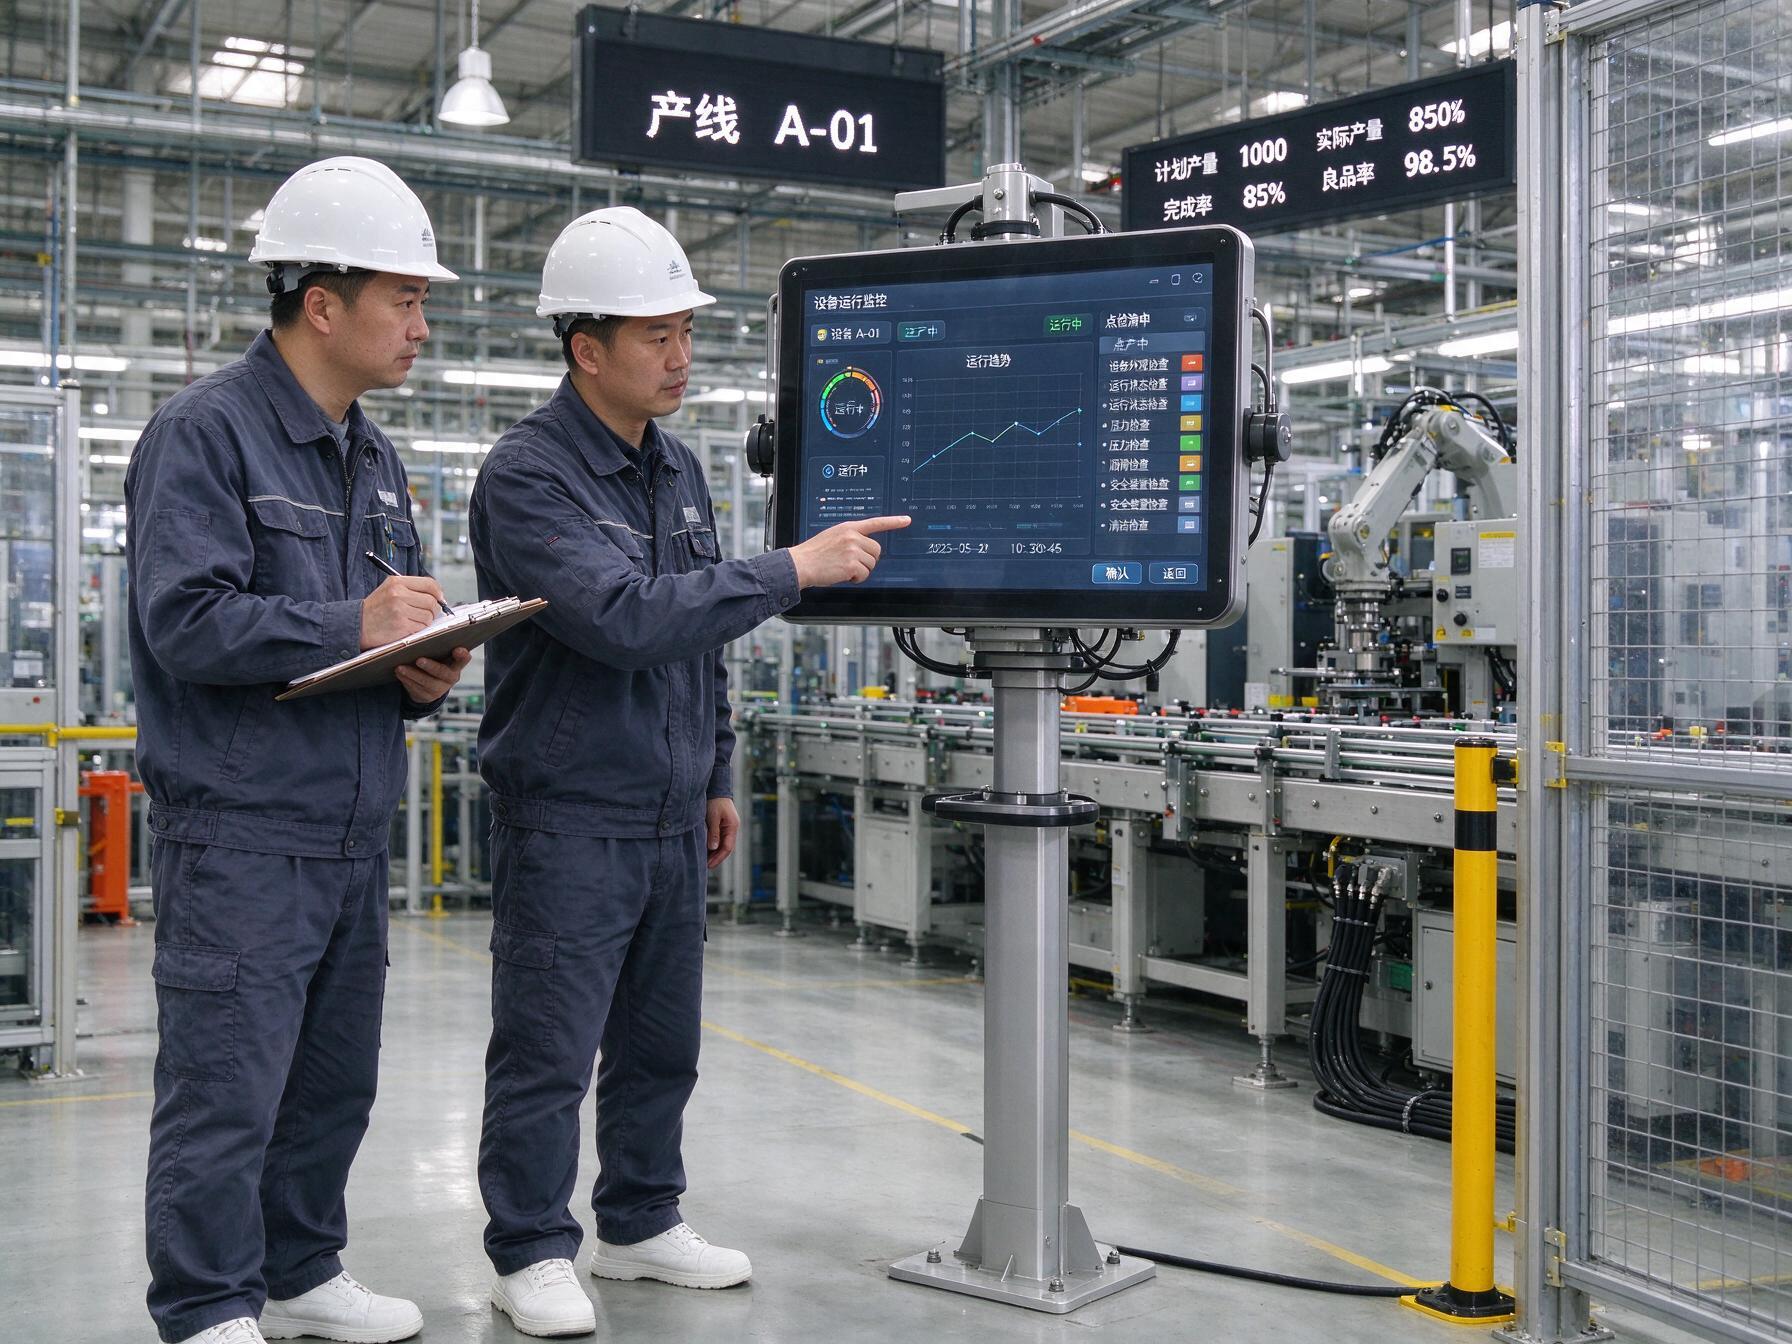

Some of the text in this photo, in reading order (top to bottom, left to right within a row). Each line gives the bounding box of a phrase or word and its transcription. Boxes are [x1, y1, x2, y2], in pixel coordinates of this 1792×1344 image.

[646, 90, 878, 153] 产线 A-01
[1154, 98, 1466, 183] 计划产量 1000 实际产量 850%
[1163, 144, 1477, 222] 完成率 85% 良品率 98.5%
[855, 328, 880, 339] A-01
[1049, 317, 1082, 331] 运行中
